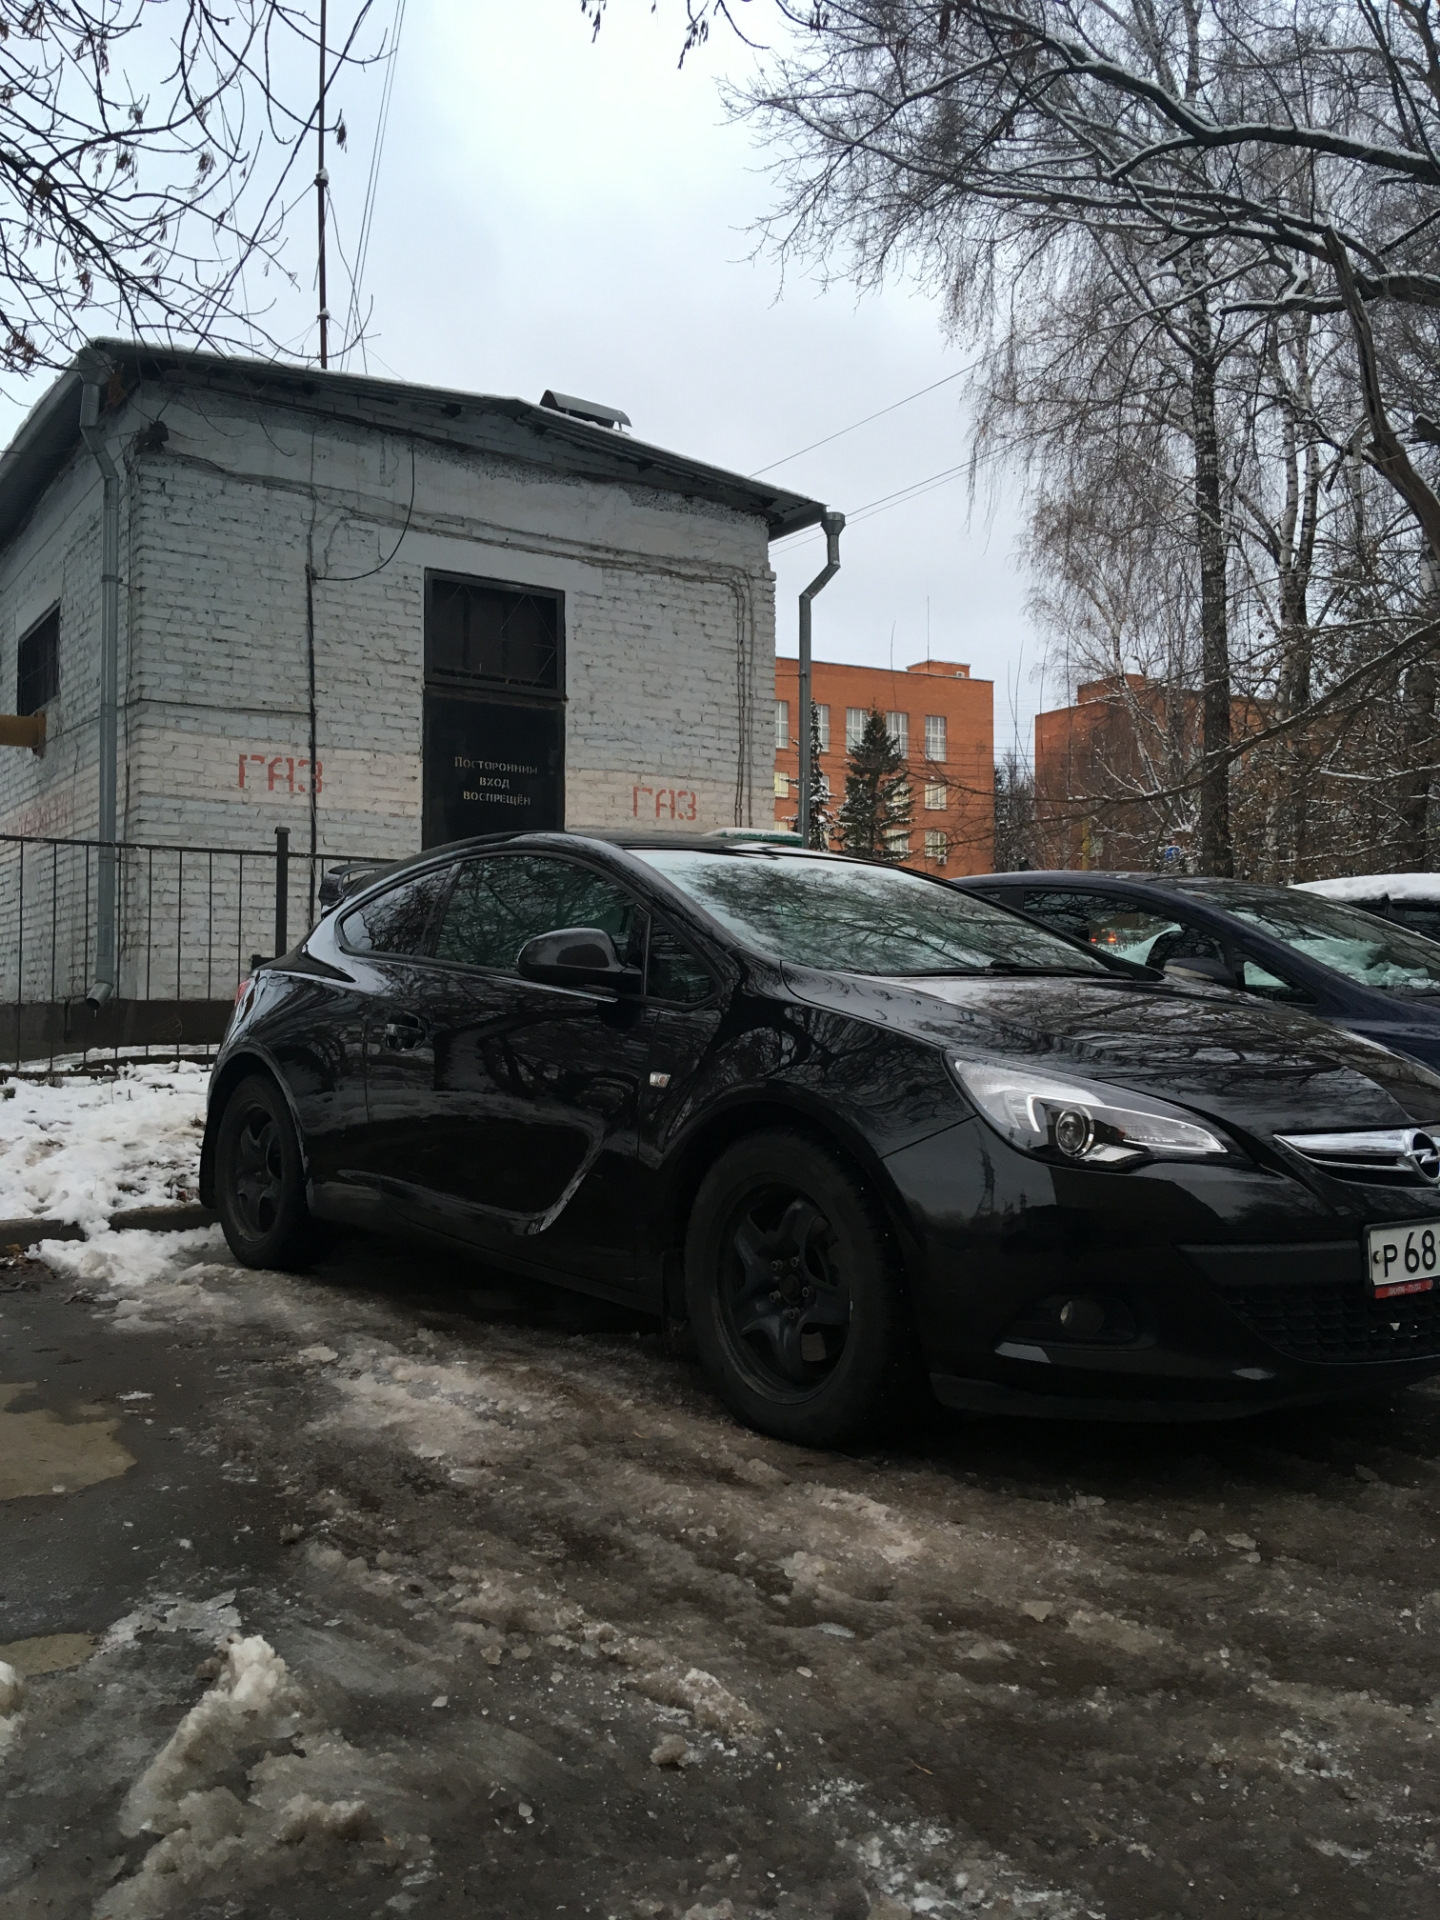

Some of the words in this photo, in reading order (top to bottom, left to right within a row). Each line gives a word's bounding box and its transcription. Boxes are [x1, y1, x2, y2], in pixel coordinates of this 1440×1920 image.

[238, 753, 324, 794] ГАЗ
[479, 776, 511, 790] ВХОД
[632, 785, 697, 821] ГАЗ
[1383, 1229, 1440, 1278] Р68
